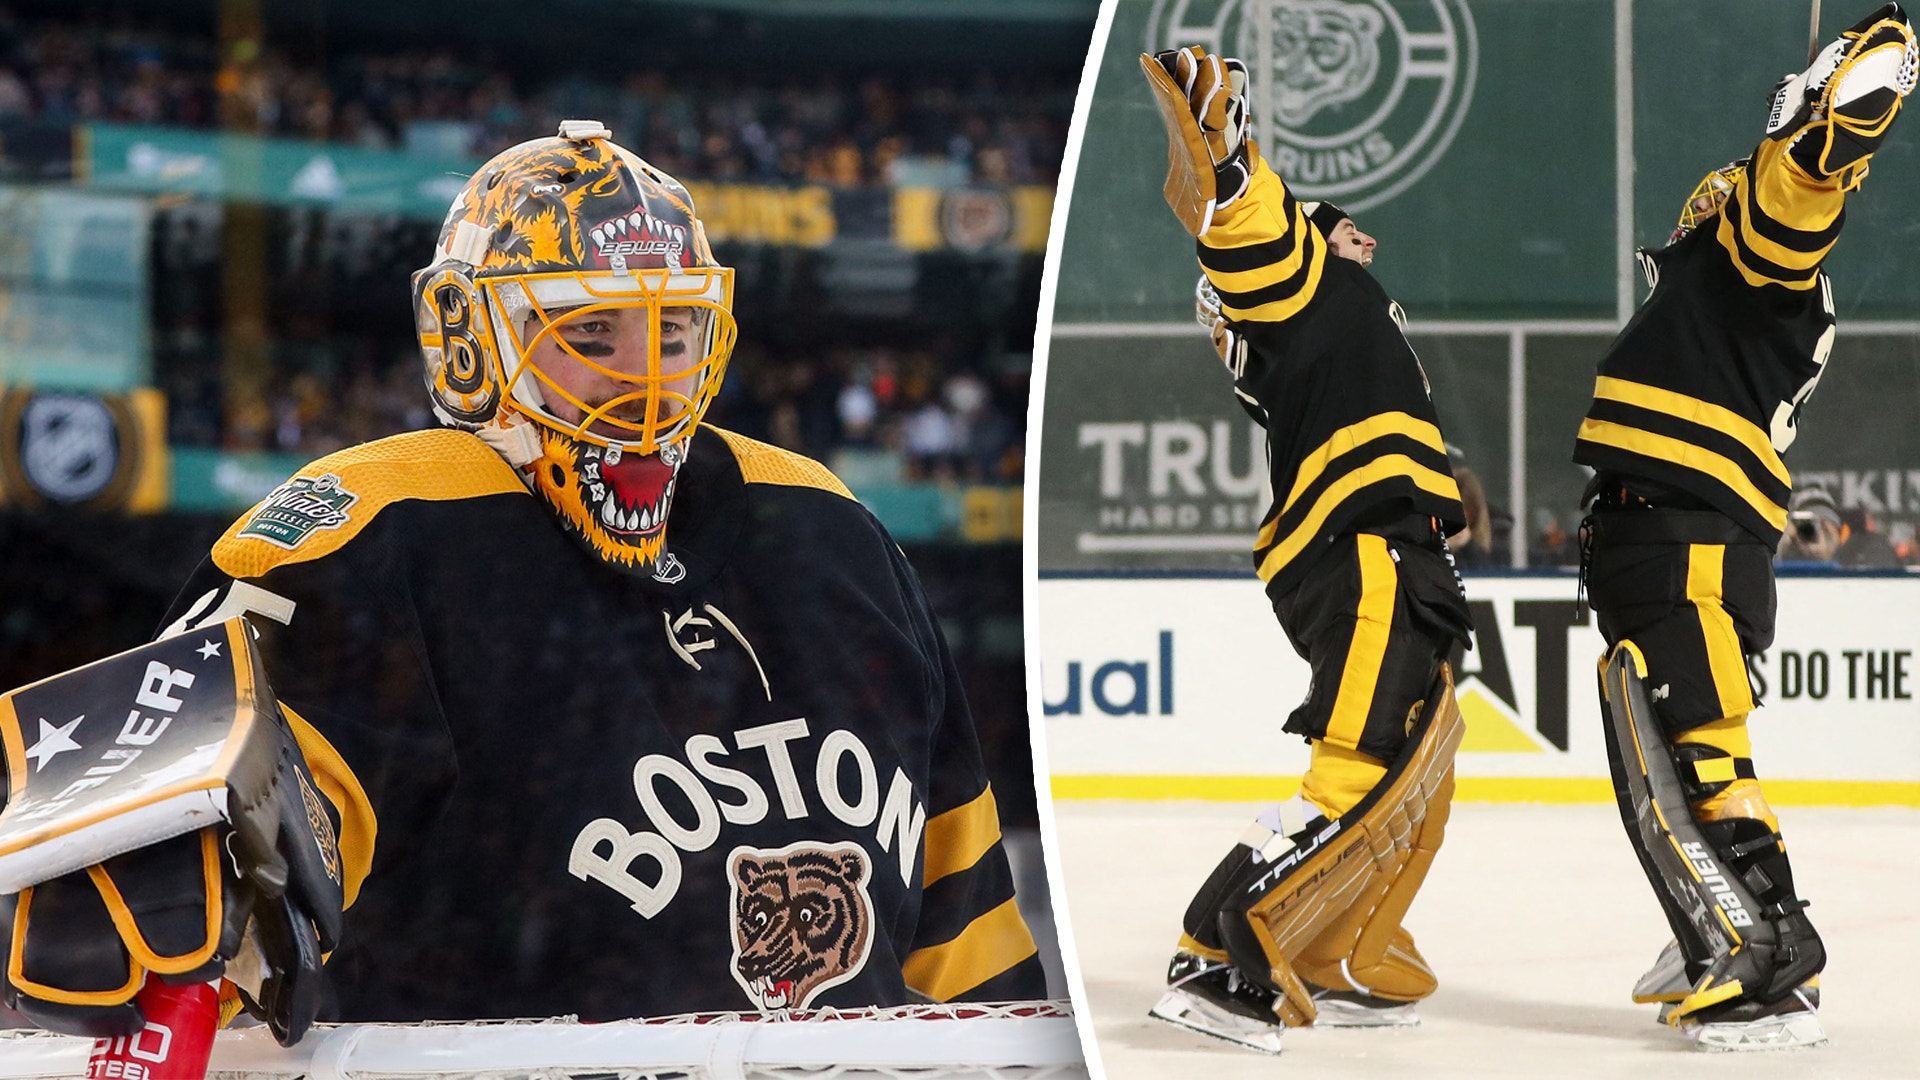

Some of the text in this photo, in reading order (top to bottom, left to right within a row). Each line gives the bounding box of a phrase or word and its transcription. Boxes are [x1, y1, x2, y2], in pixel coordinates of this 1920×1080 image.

[1768, 89, 1787, 128] BAUER
[598, 241, 683, 256] BAUER
[256, 485, 345, 525] Winter
[262, 510, 313, 529] CLASSIC
[256, 523, 290, 537] BOSTON
[1781, 650, 1829, 699] DO
[1842, 650, 1912, 699] THE
[568, 717, 926, 920] BOSTON
[1248, 818, 1341, 894] TRUE
[1681, 841, 1754, 928] BAUER
